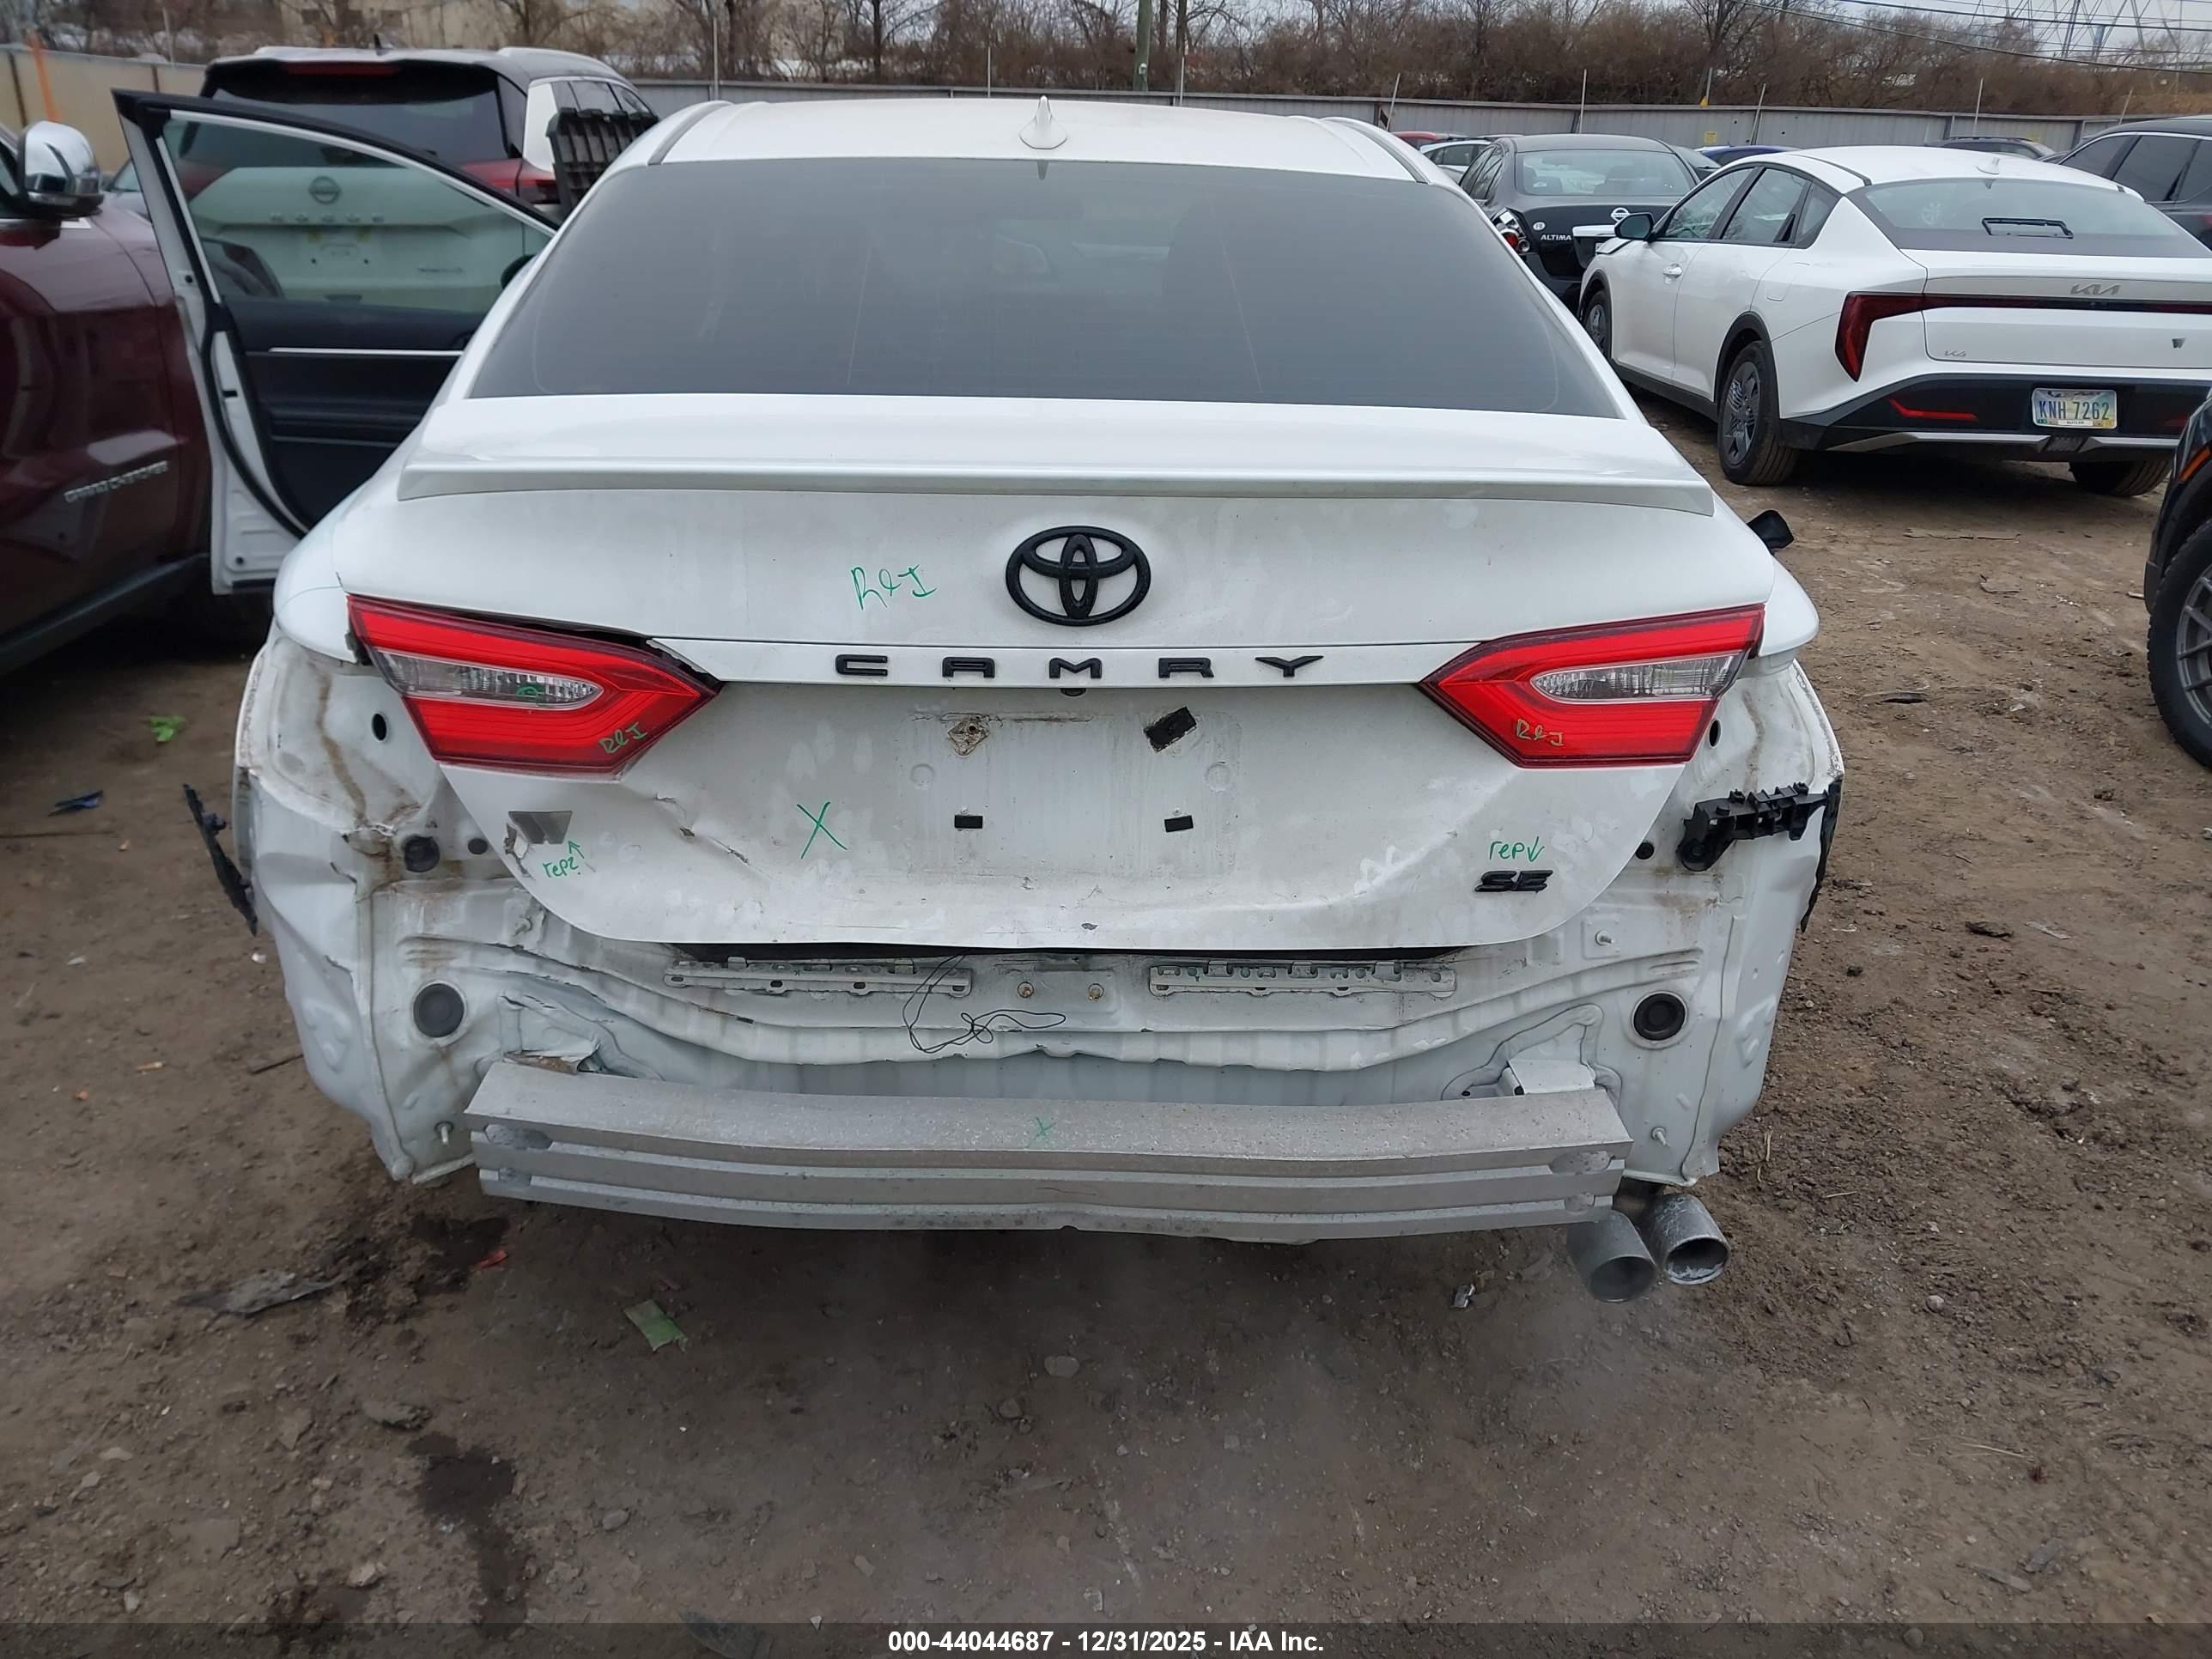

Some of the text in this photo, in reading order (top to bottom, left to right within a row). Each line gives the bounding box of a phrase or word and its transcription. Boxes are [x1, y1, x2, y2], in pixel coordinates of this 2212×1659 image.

[2039, 400, 2110, 420] KNH 7262
[836, 654, 1324, 678] CAMRY
[1474, 870, 1553, 892] SE
